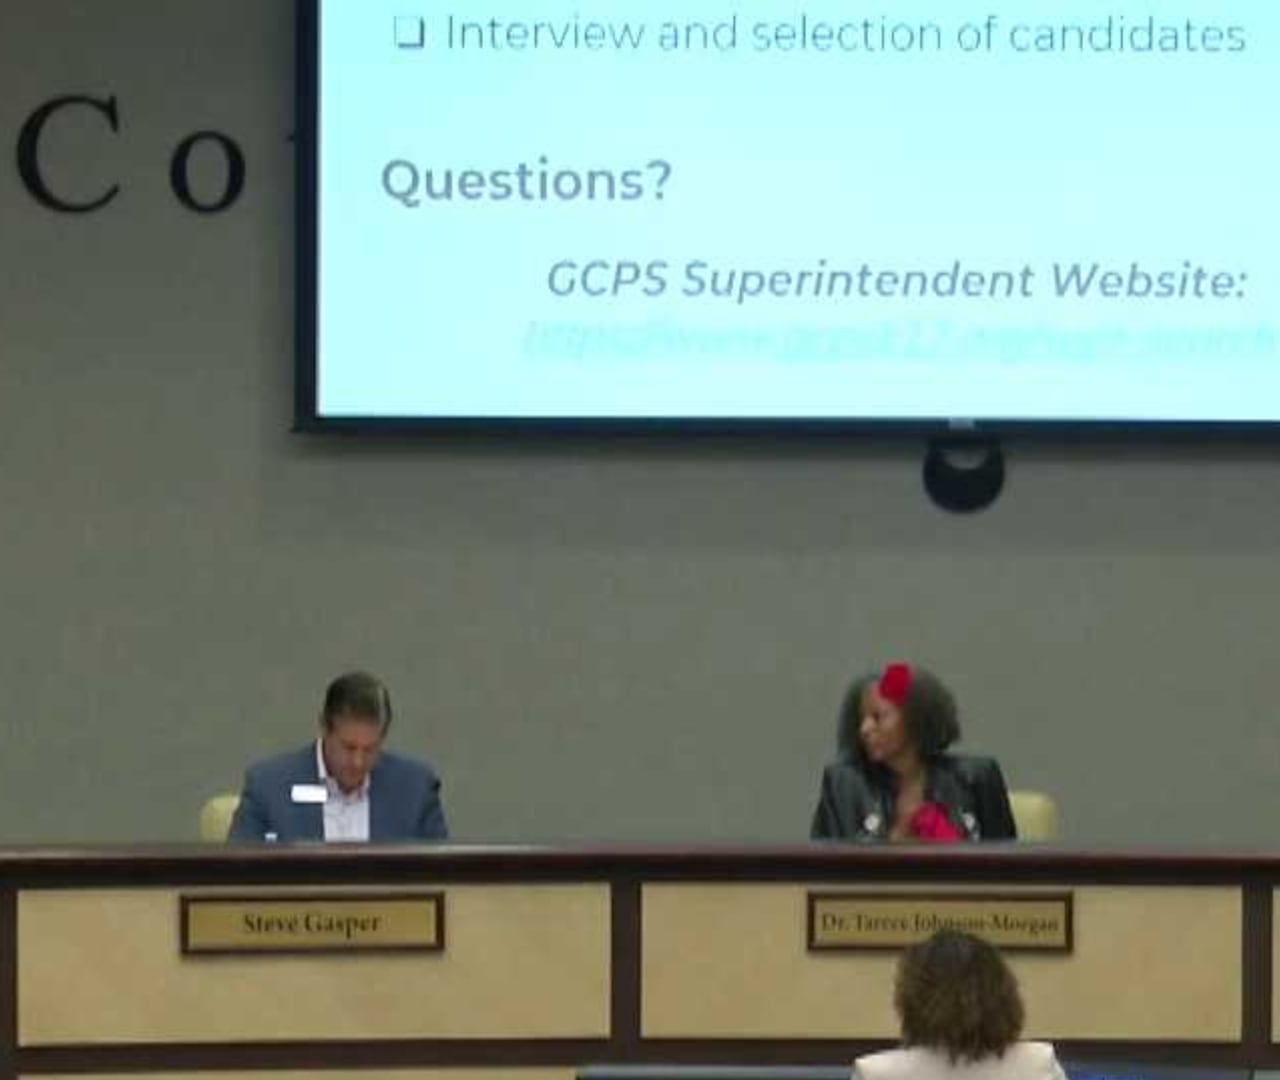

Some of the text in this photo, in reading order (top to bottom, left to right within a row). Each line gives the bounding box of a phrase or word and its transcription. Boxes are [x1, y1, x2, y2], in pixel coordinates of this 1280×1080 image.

[447, 13, 1247, 53] Interview and selection of candidates
[14, 94, 297, 214] Co
[380, 155, 673, 209] Questions?
[546, 257, 1249, 306] GCPS Superintendent Website:
[243, 911, 382, 940] Steve Gasper
[822, 913, 851, 931] Dr.
